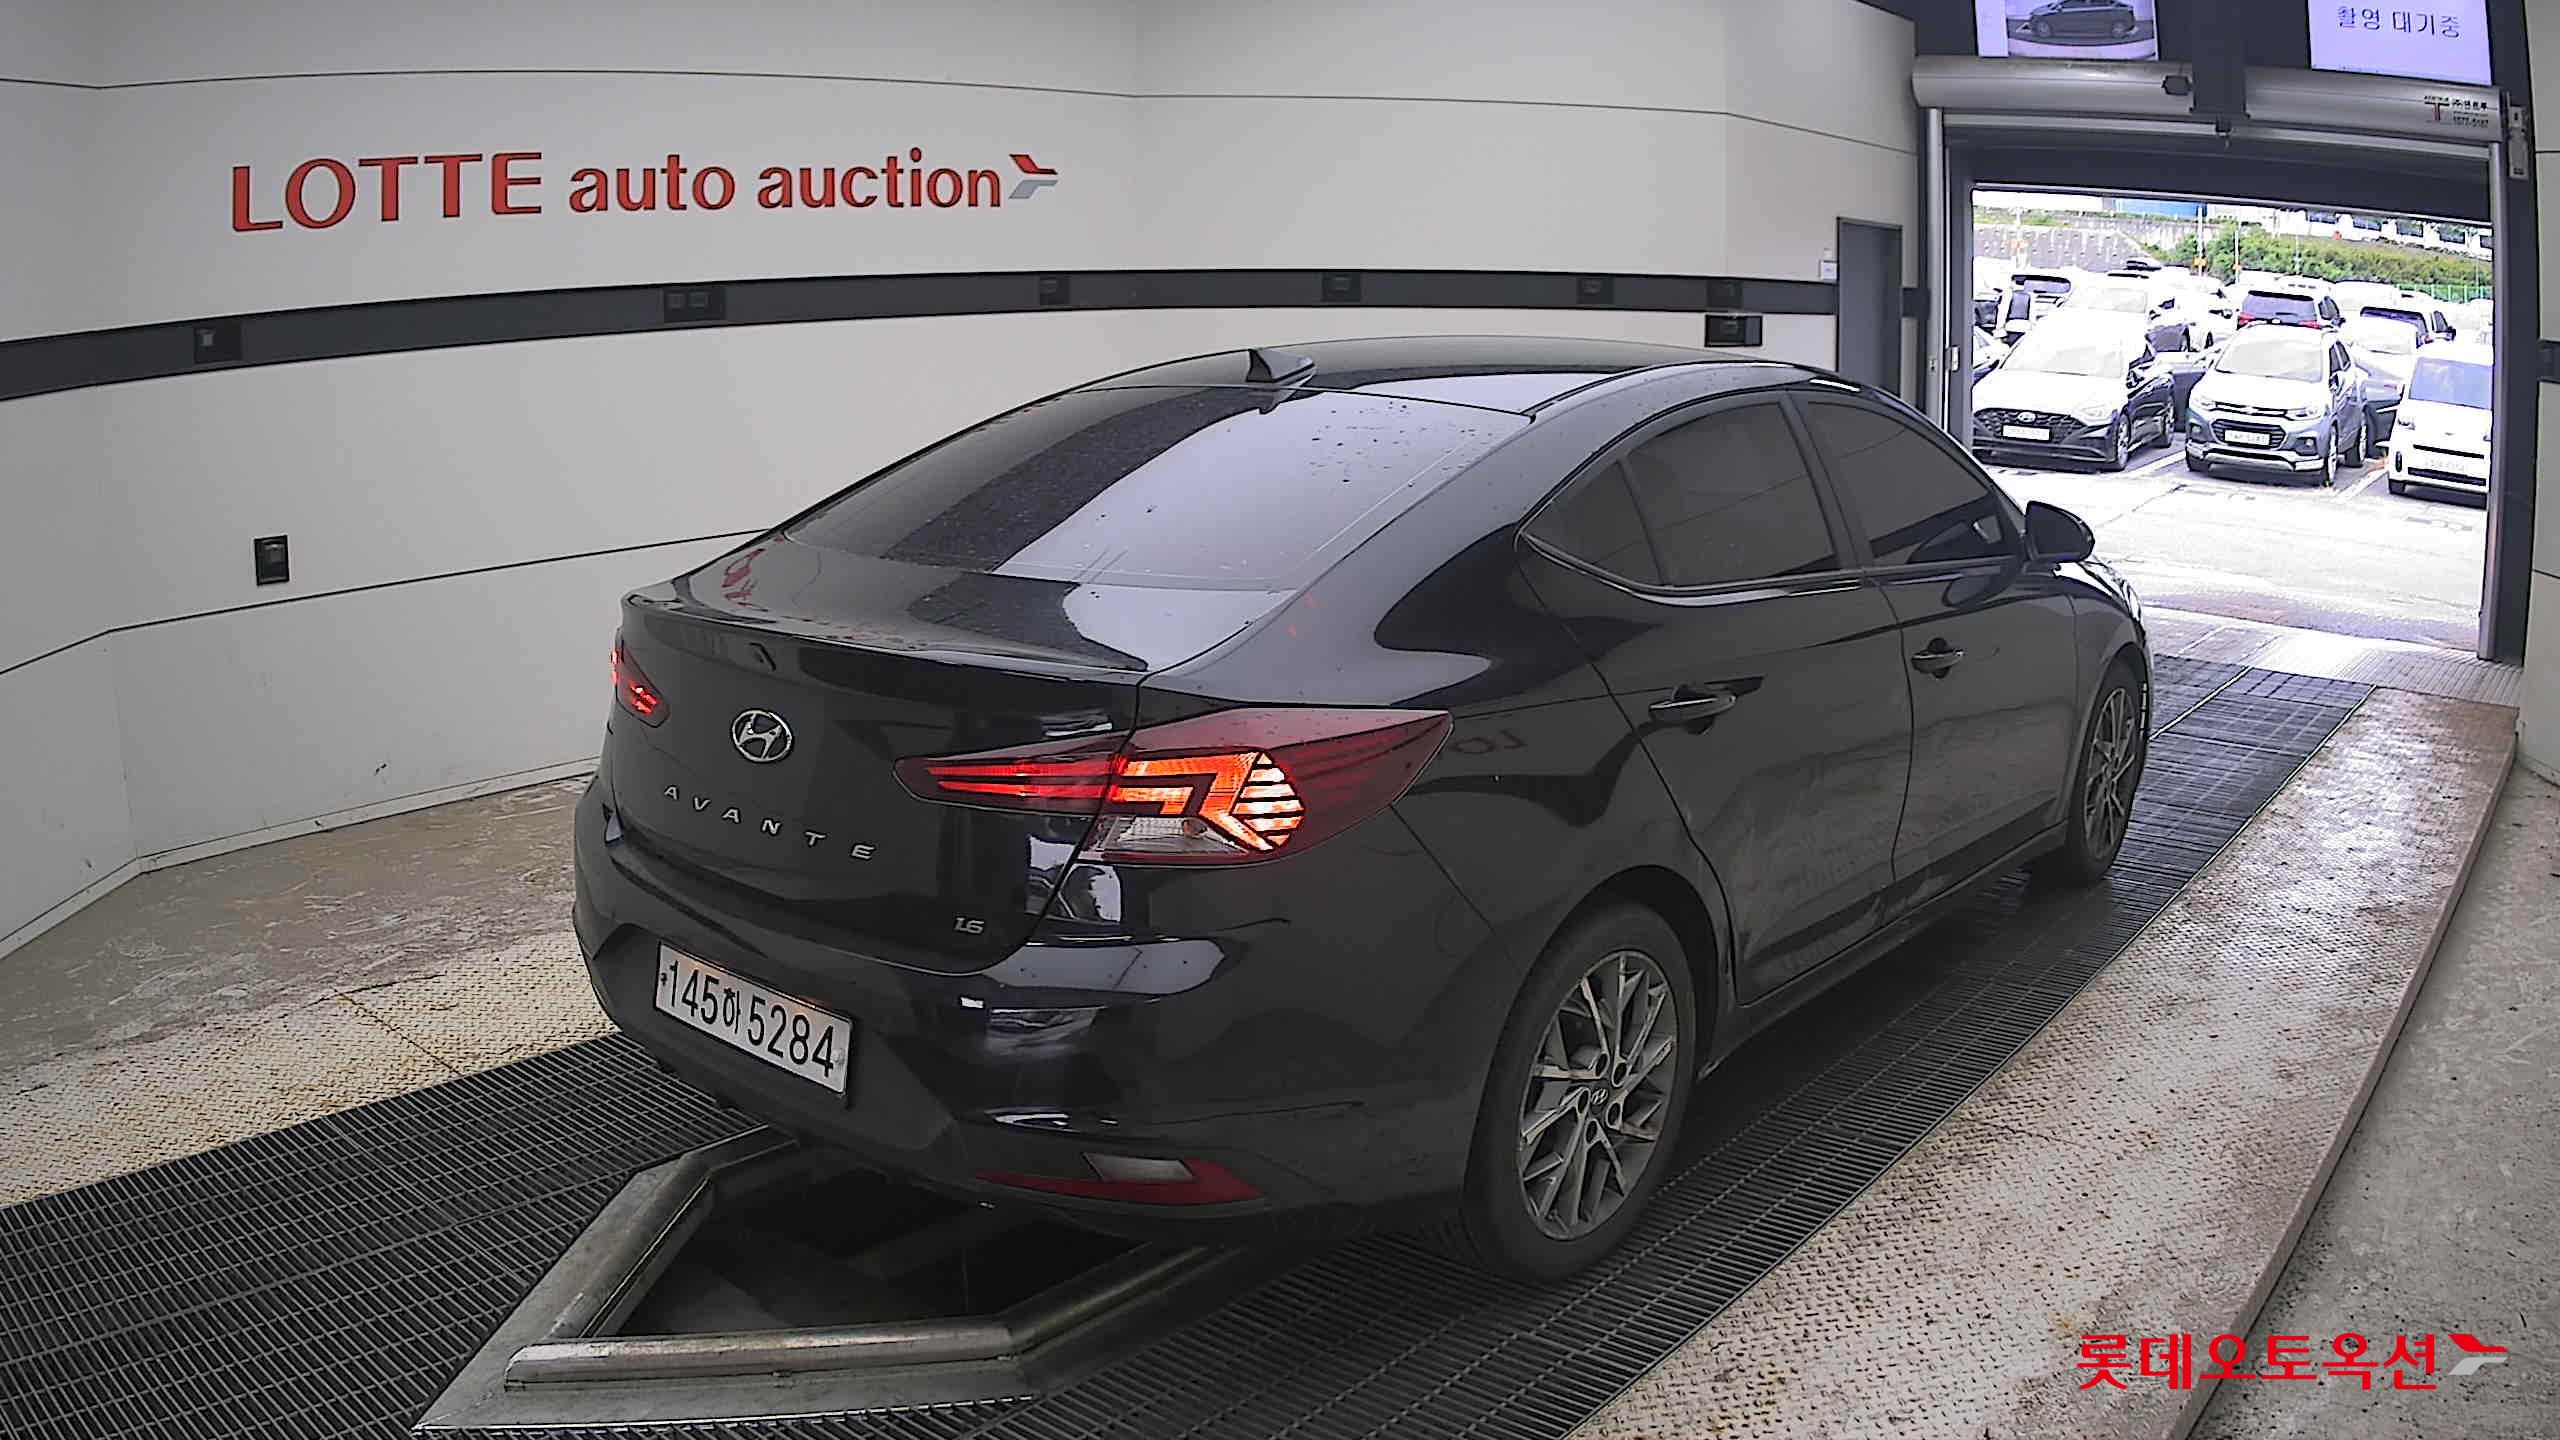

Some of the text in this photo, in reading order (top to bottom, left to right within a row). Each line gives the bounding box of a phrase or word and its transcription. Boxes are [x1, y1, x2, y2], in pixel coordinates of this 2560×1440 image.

[2338, 6, 2460, 39] 촬영 대기중
[231, 147, 1002, 233] LOTTE auto auction
[663, 785, 877, 861] AVANTE
